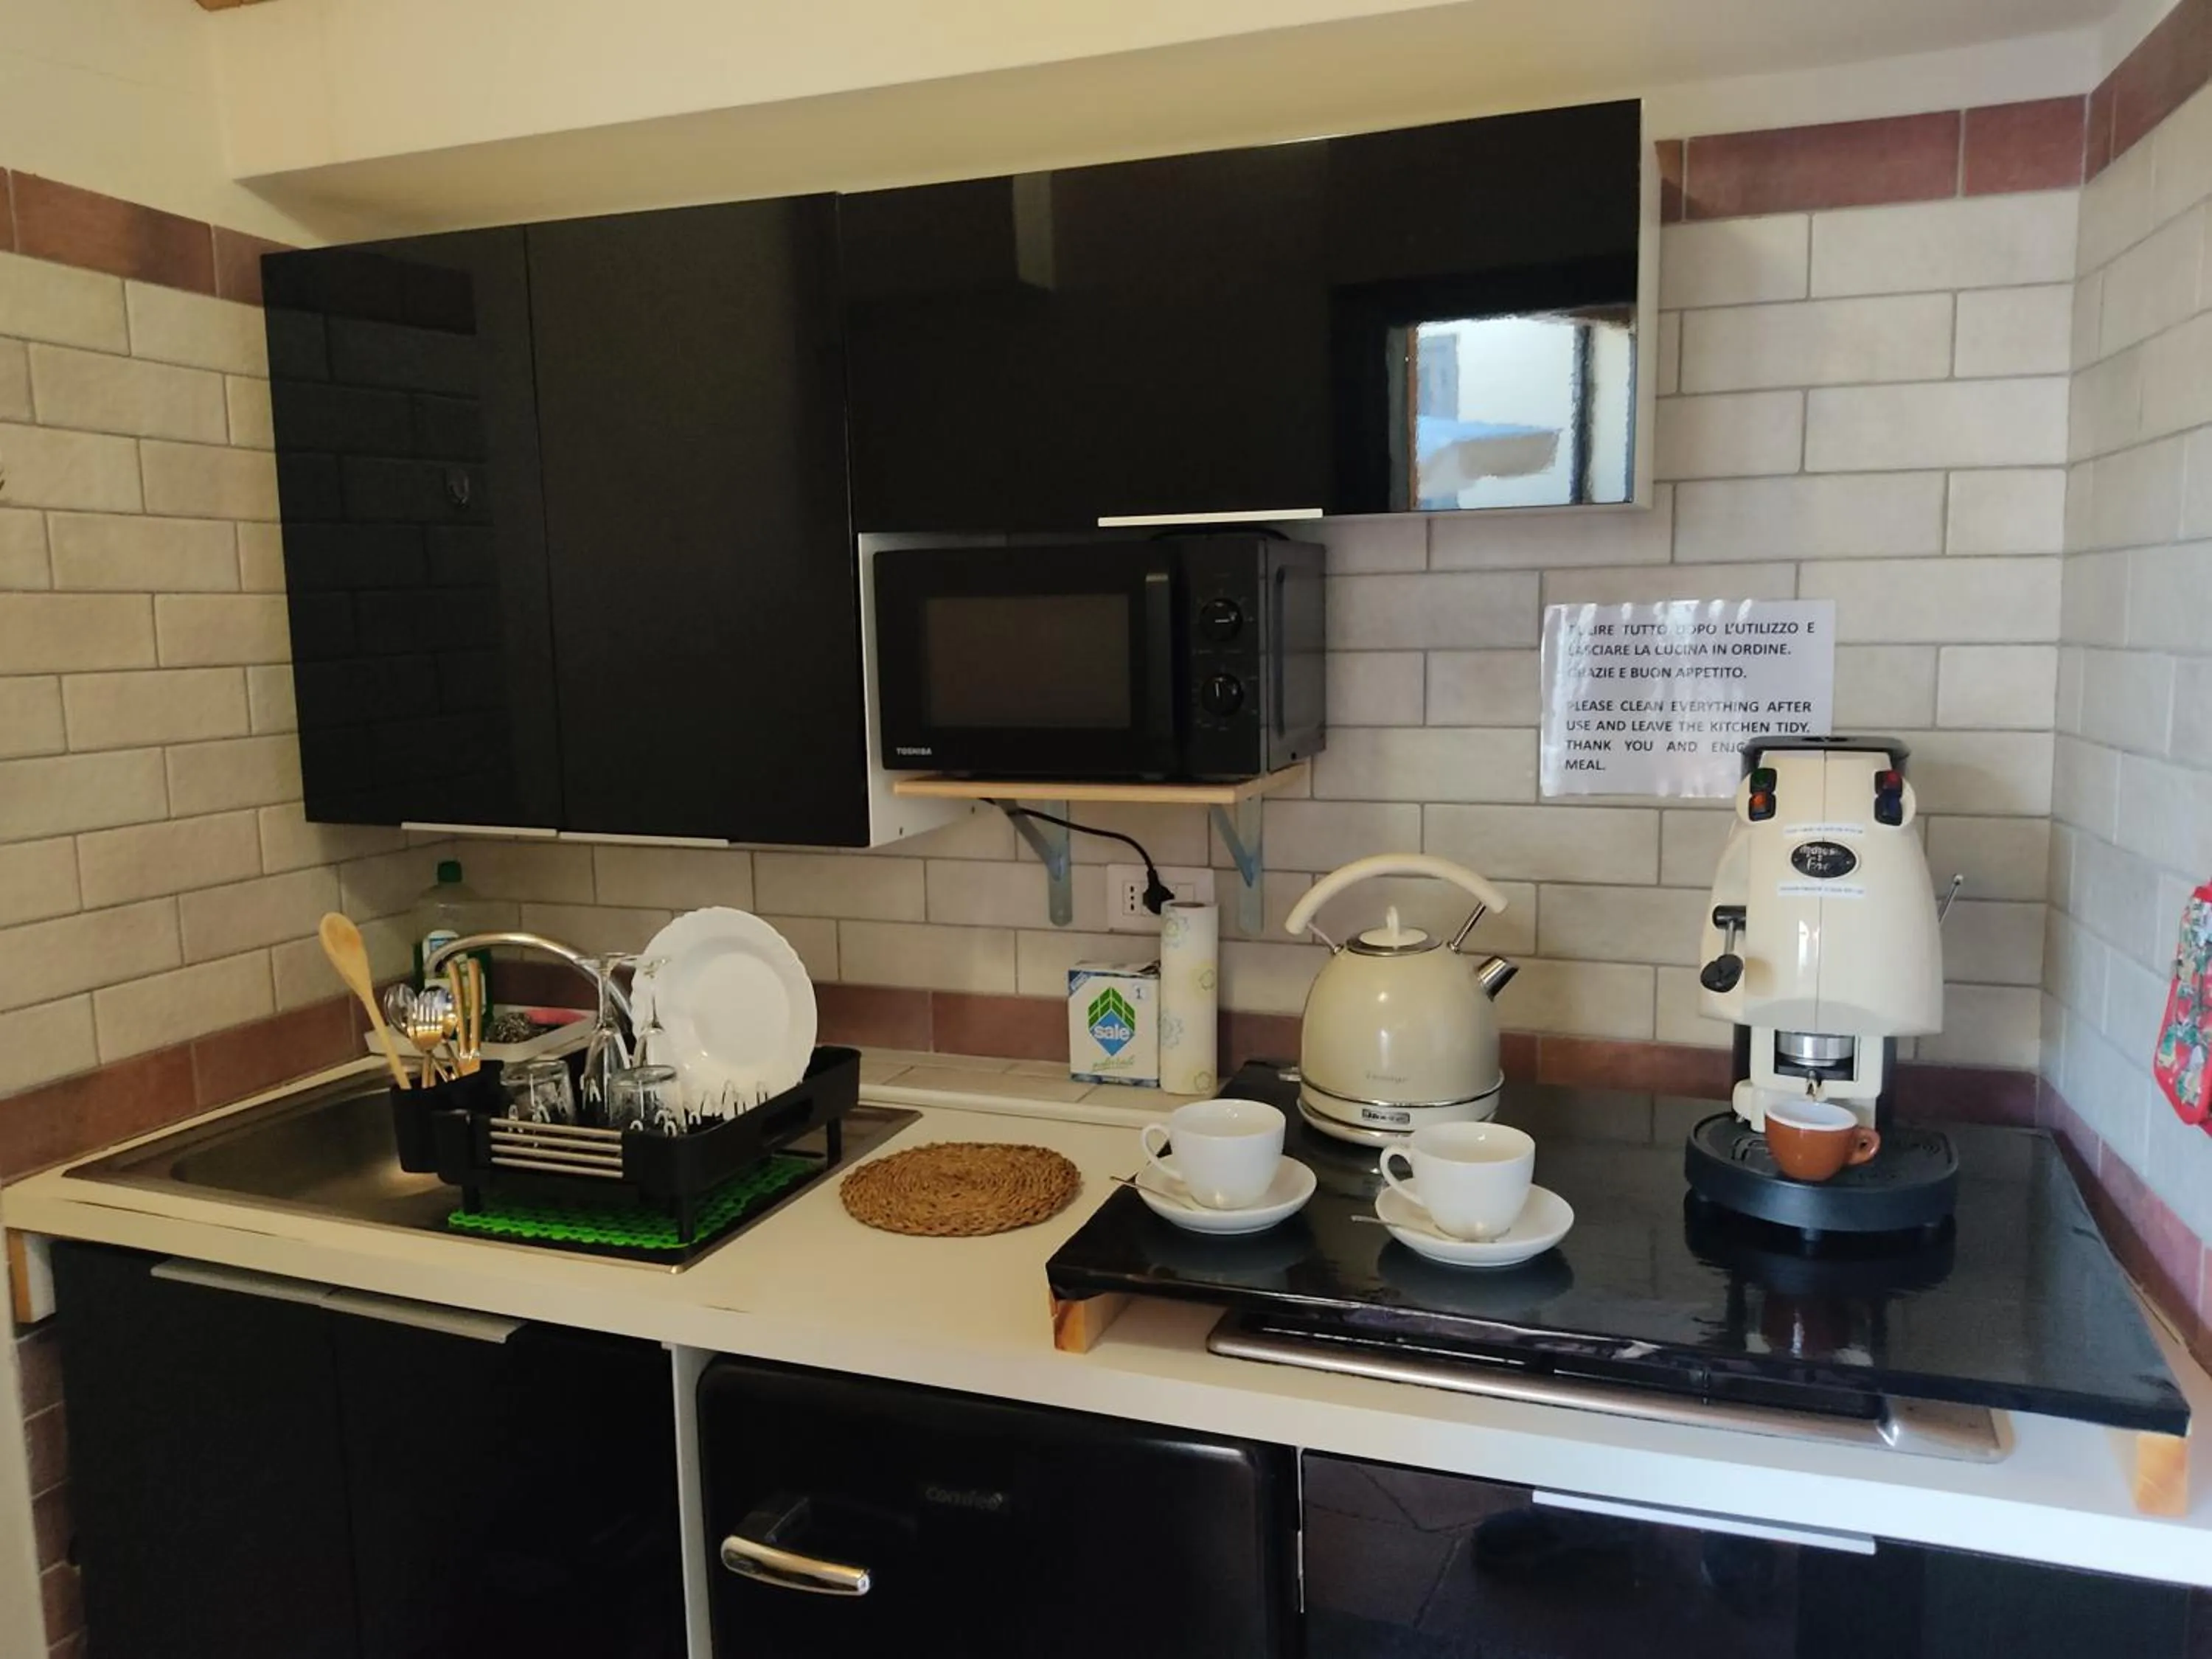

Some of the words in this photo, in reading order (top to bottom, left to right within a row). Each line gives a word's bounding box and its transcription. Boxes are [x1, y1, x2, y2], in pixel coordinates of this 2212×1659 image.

[1624, 625, 1668, 636] TUTTO
[1807, 622, 1815, 633] E
[1635, 644, 1651, 655] LA
[1712, 644, 1727, 655] IN
[1731, 643, 1791, 655] ORDINE.
[1619, 667, 1626, 678] E
[1630, 667, 1672, 679] BUON
[1675, 667, 1747, 678] APPETITO.
[1621, 700, 1663, 712] CLEAN
[1671, 701, 1759, 712] EVERYTHING
[1767, 701, 1812, 712] AFTER
[1566, 720, 1590, 731] USE
[1596, 720, 1626, 731] AND
[1632, 720, 1673, 731] LEAVE
[1679, 721, 1705, 732] THE
[1710, 721, 1770, 732] KITCHEN
[1775, 722, 1810, 733] TIDY.
[897, 747, 932, 756] TOSHIBA
[1565, 740, 1611, 751] THANK
[1625, 740, 1653, 751] YOU
[1666, 741, 1697, 752] AND
[1565, 759, 1605, 771] MEAL.
[1093, 1024, 1130, 1041] sale
